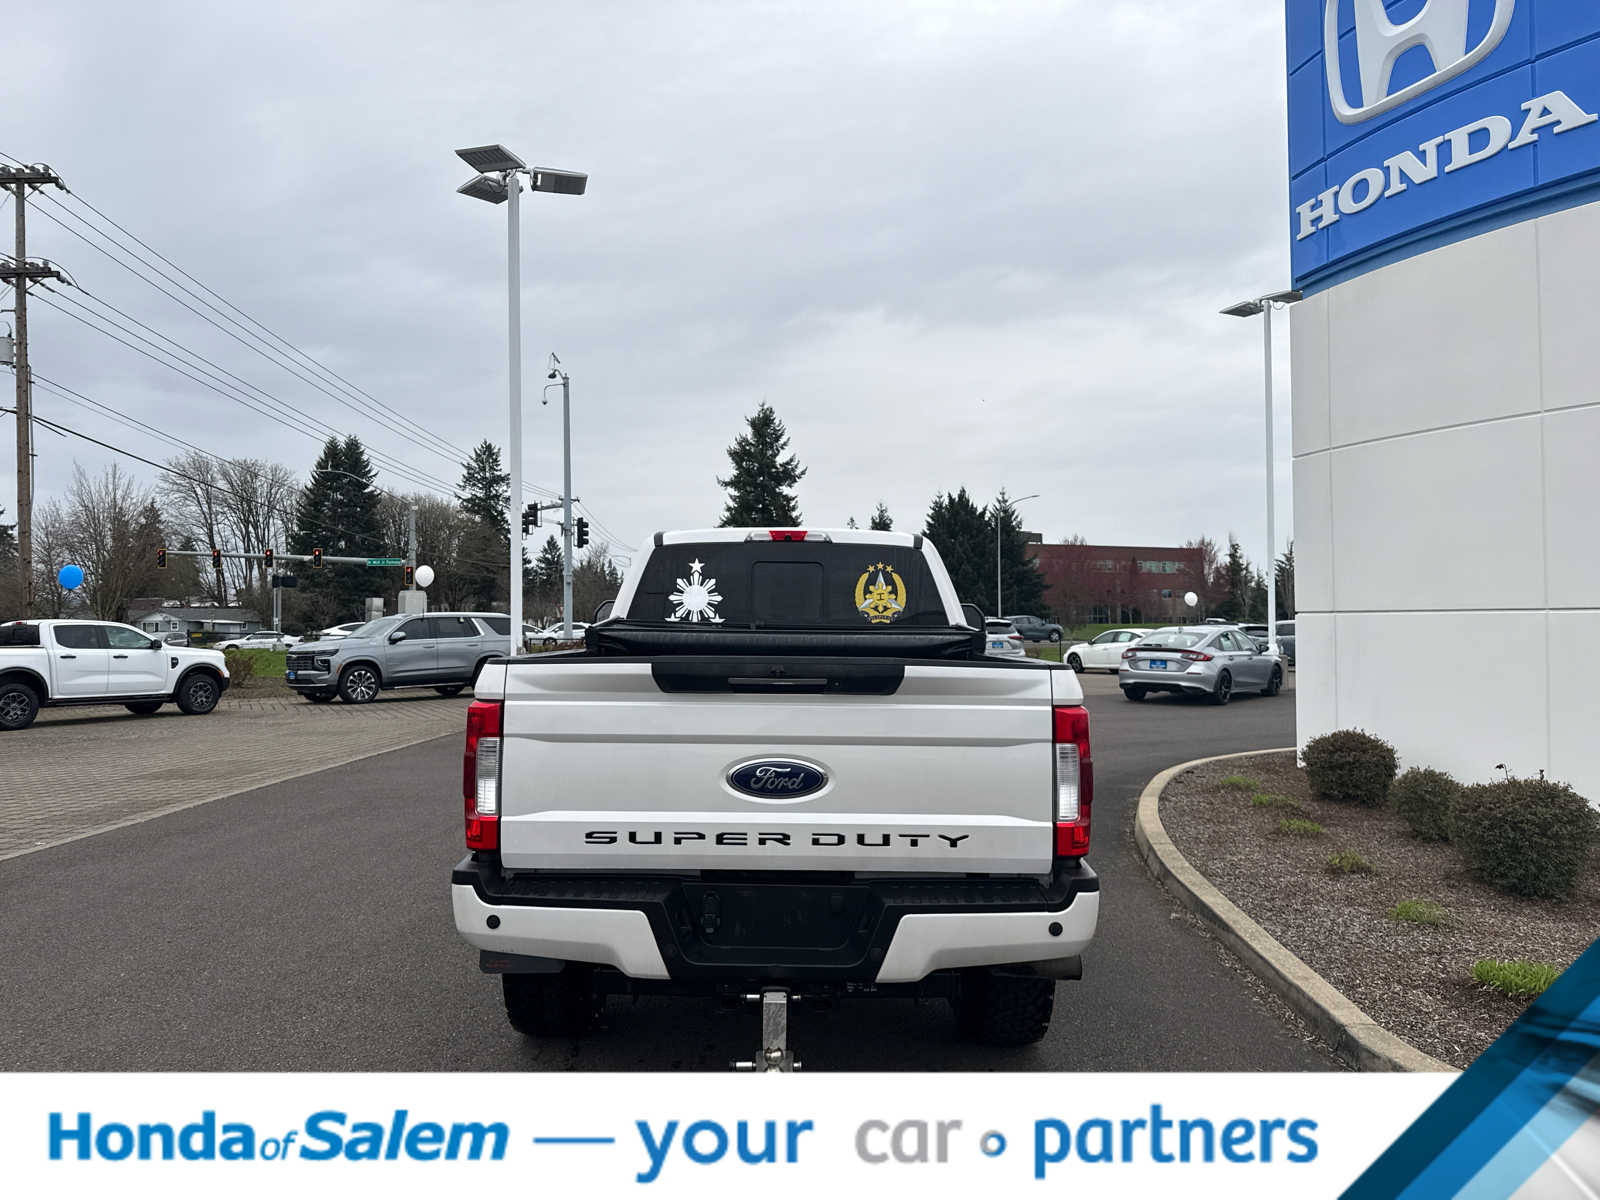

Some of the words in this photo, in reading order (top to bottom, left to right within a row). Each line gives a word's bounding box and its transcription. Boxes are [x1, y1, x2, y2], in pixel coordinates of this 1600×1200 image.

[1295, 90, 1598, 241] HONDA
[750, 766, 805, 790] Ford
[584, 831, 791, 846] SUPER
[811, 832, 969, 848] DUTY
